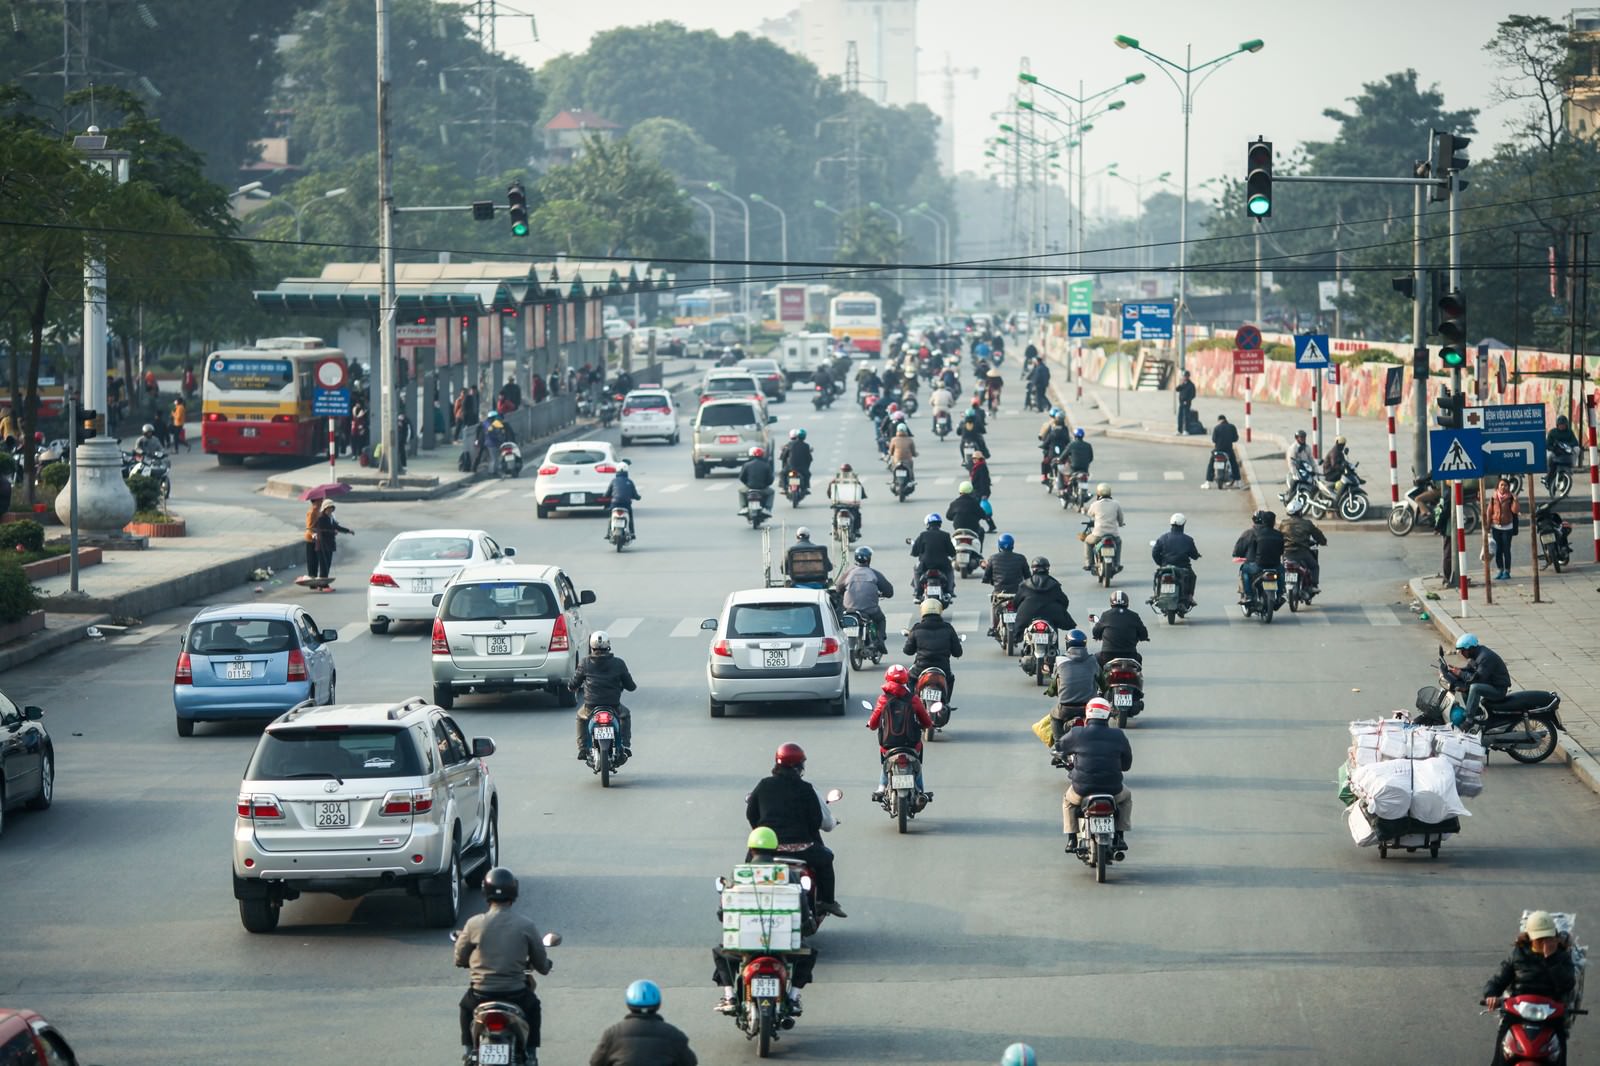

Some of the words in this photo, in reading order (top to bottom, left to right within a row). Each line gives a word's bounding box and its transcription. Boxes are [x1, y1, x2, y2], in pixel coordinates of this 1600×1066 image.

[492, 637, 506, 645] 30K
[491, 645, 507, 653] 9183
[233, 662, 246, 670] 30A
[322, 803, 342, 813] 30X
[319, 814, 345, 825] 2829
[755, 987, 775, 995] 7231
